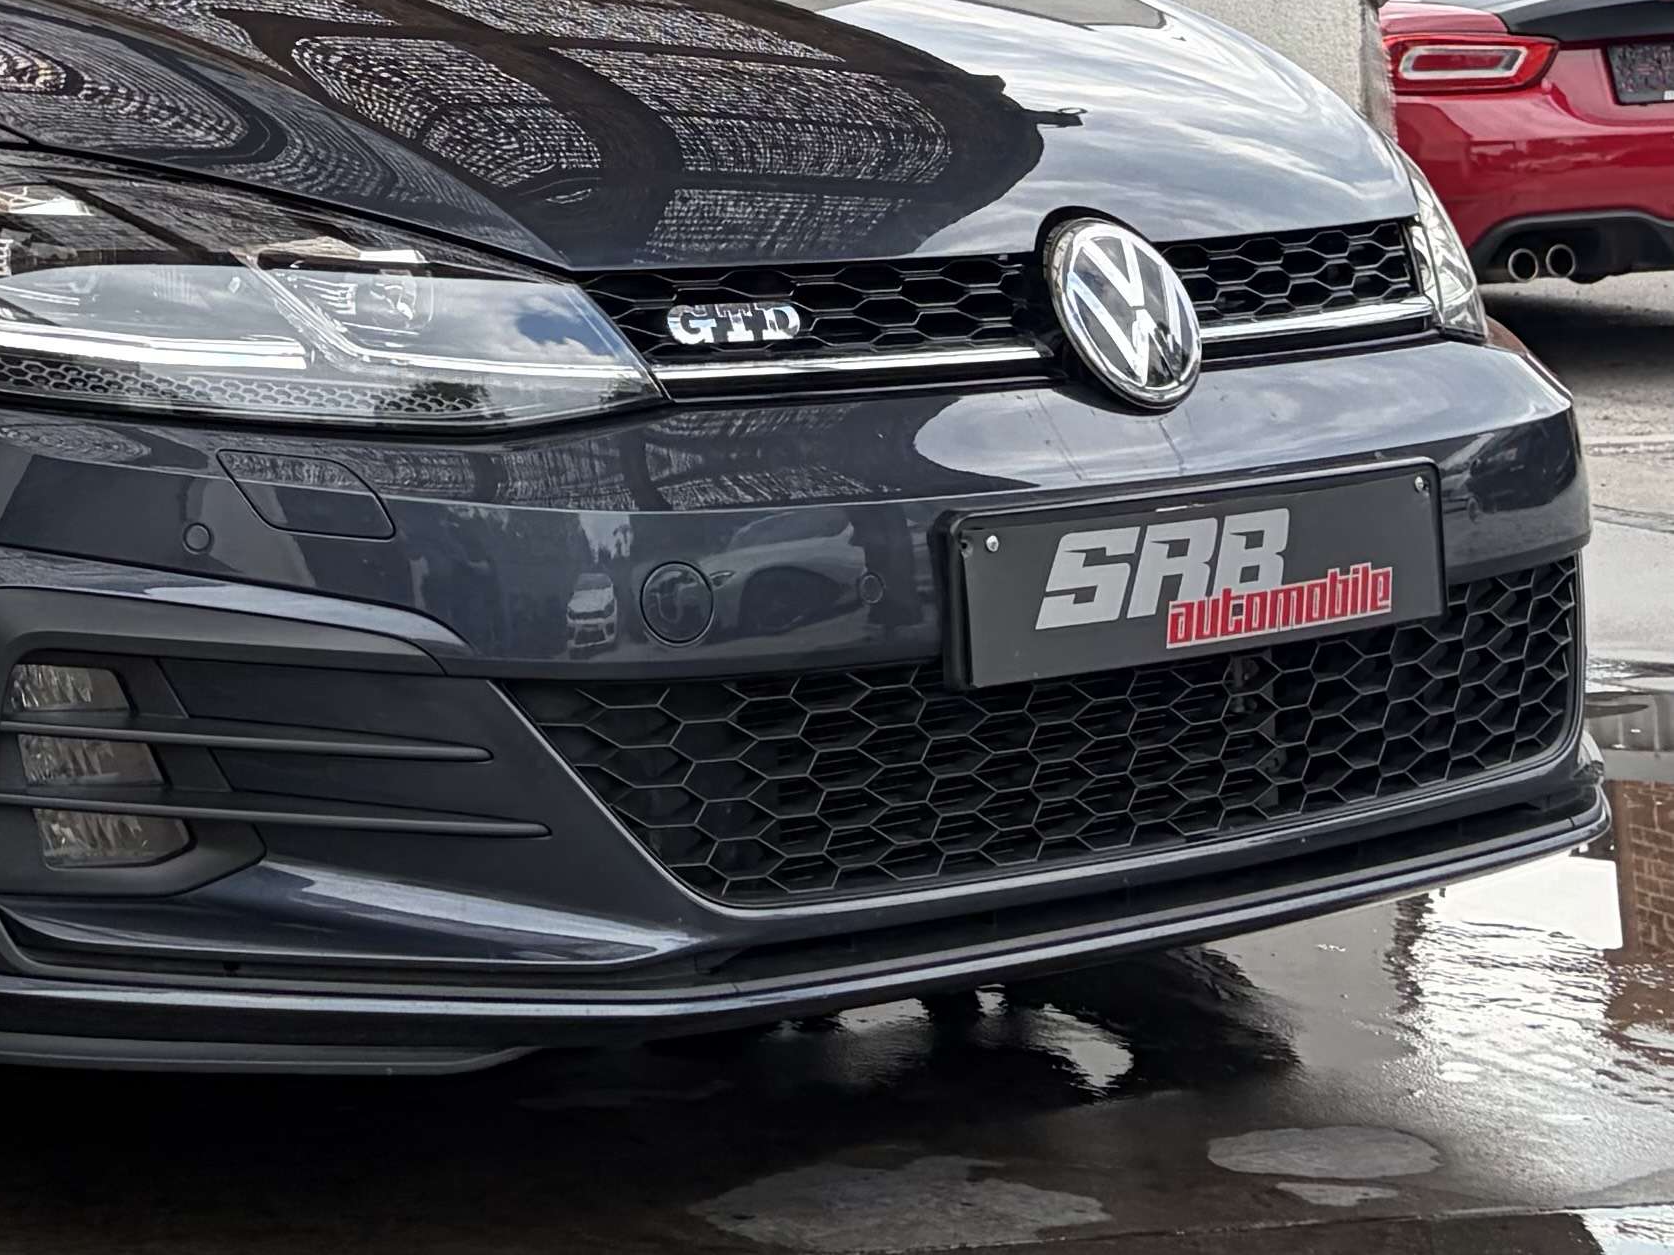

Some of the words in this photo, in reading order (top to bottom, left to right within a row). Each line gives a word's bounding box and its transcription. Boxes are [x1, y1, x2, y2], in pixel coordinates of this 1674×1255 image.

[667, 302, 801, 344] GTD
[1035, 508, 1290, 630] SRB
[1167, 562, 1393, 648] automobile
